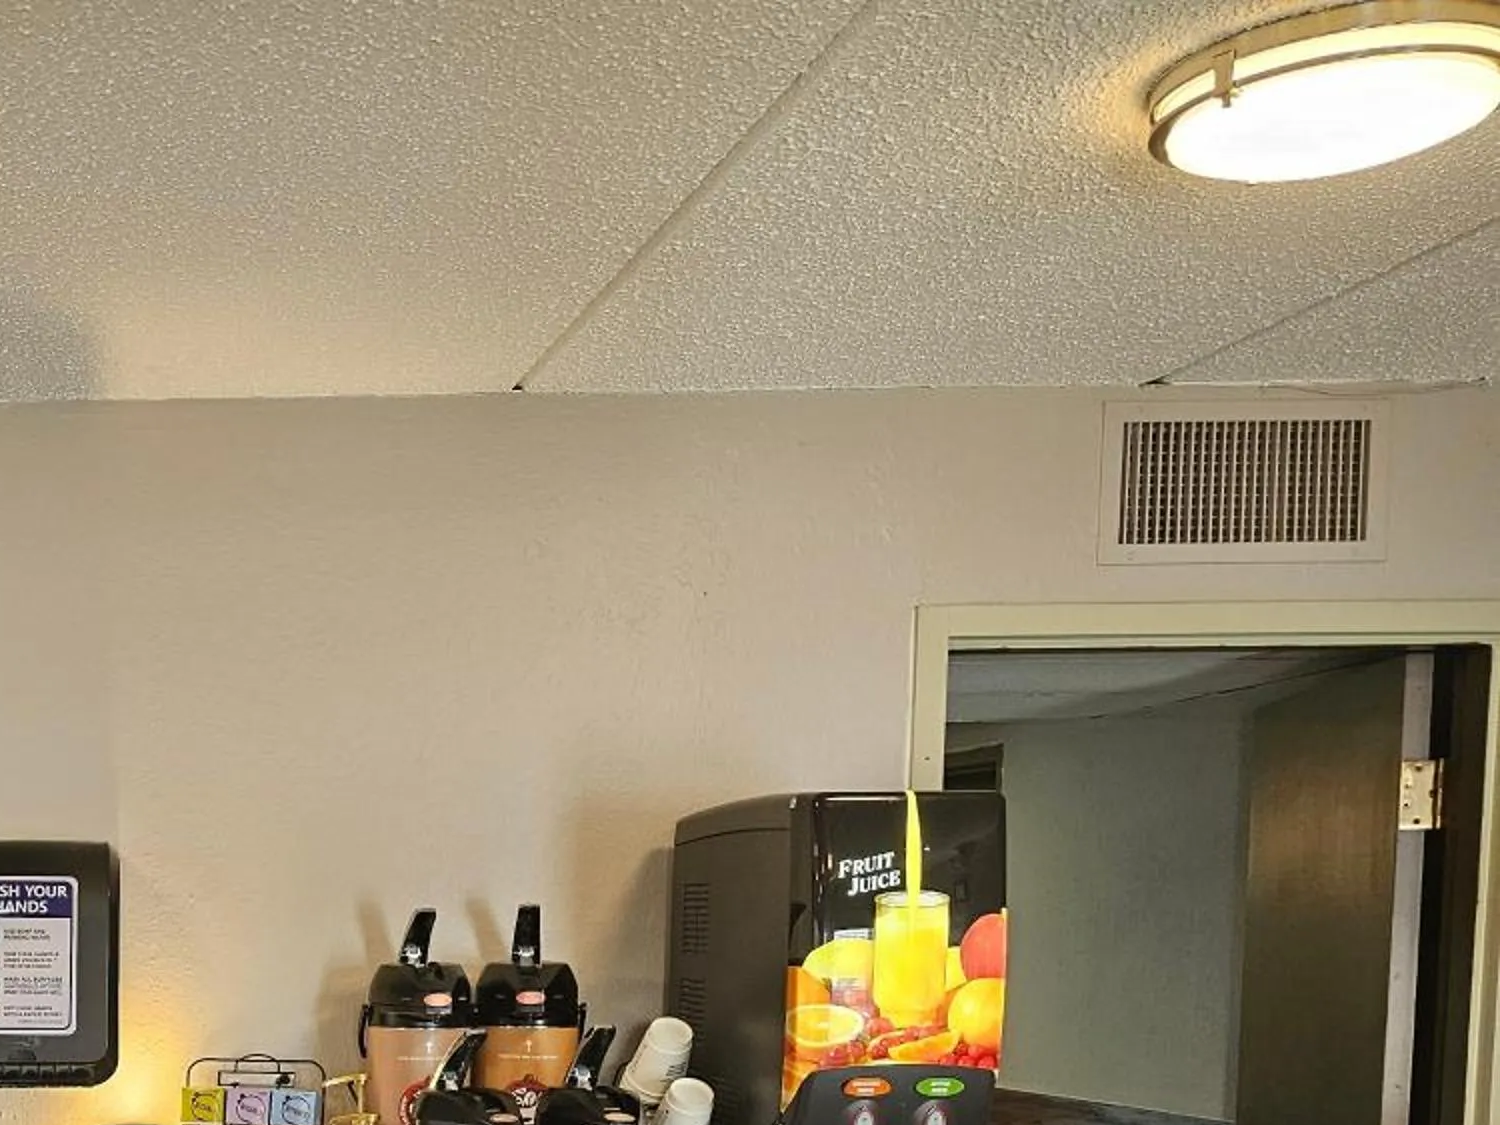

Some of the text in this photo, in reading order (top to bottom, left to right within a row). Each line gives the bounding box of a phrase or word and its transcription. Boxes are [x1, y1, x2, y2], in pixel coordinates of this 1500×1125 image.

[837, 851, 895, 879] FRUIT
[25, 884, 67, 897] YOUR
[847, 869, 901, 897] JUICE
